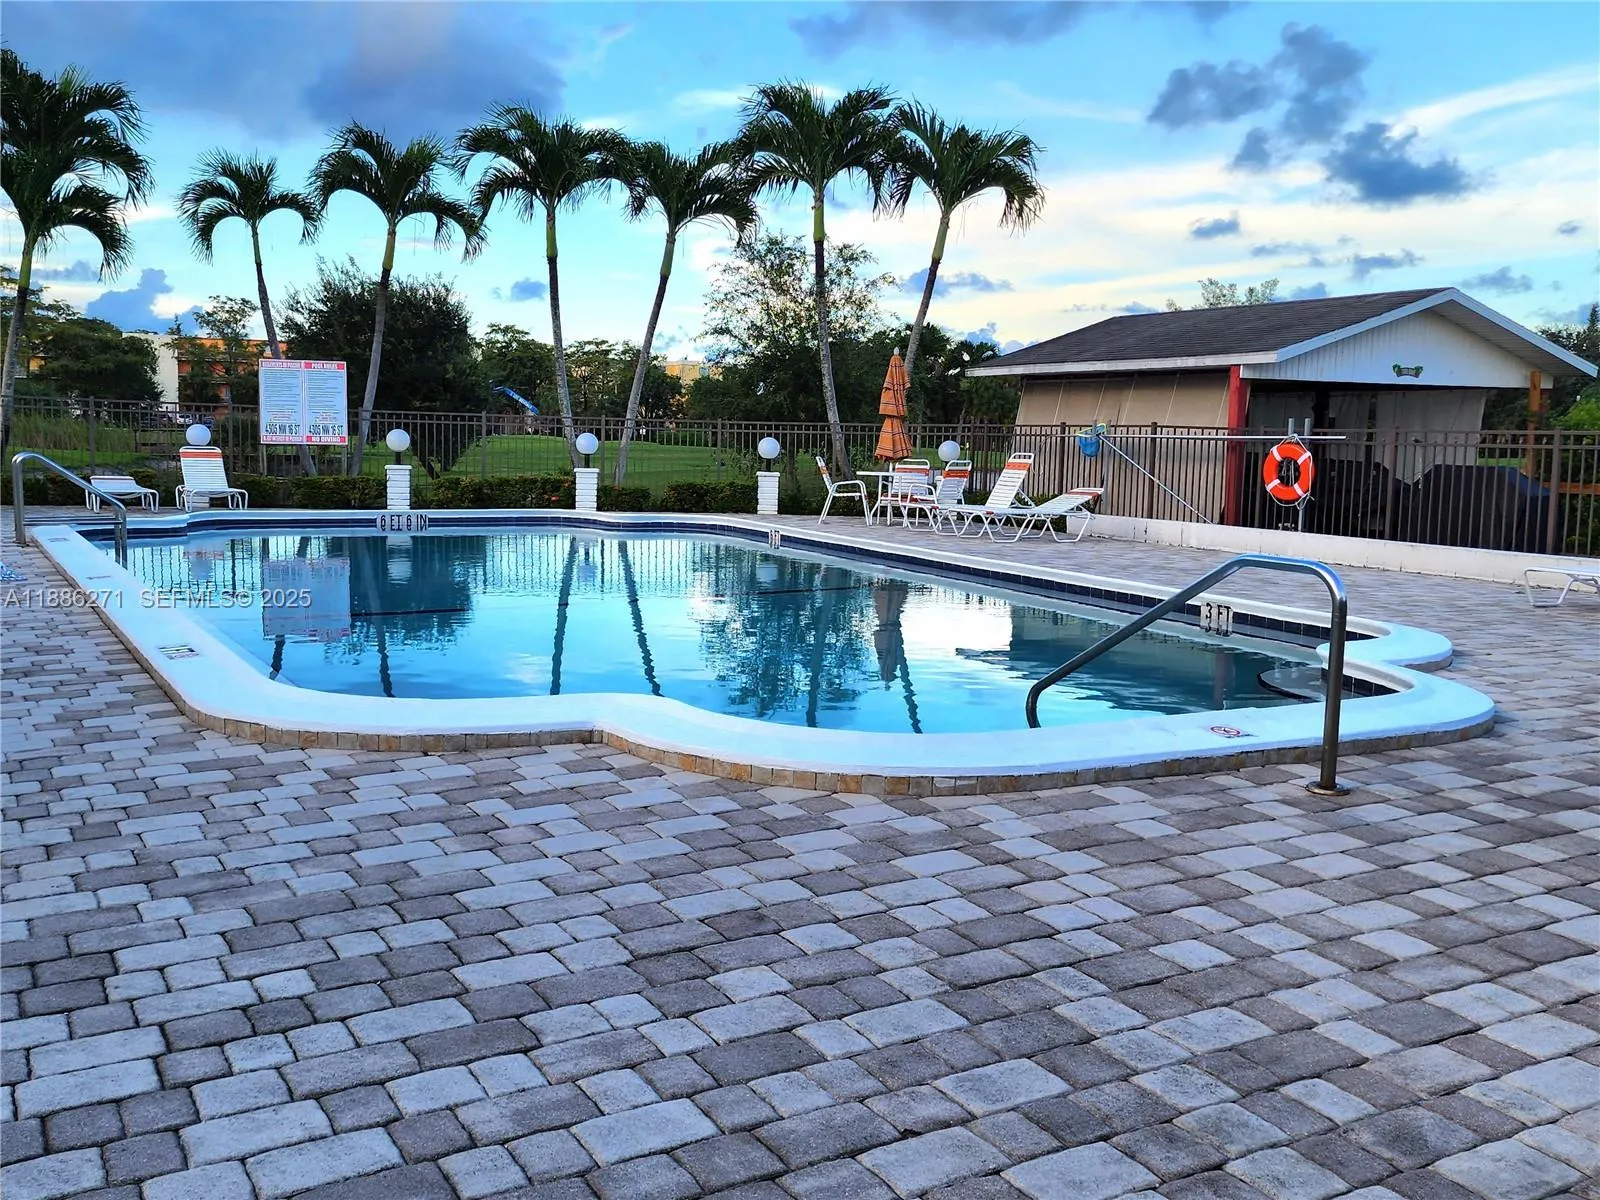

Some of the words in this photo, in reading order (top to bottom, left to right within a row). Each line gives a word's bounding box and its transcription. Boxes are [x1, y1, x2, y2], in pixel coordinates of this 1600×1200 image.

[278, 424, 286, 434] NW
[294, 424, 300, 434] ST
[322, 424, 330, 435] NW
[337, 424, 344, 435] ST
